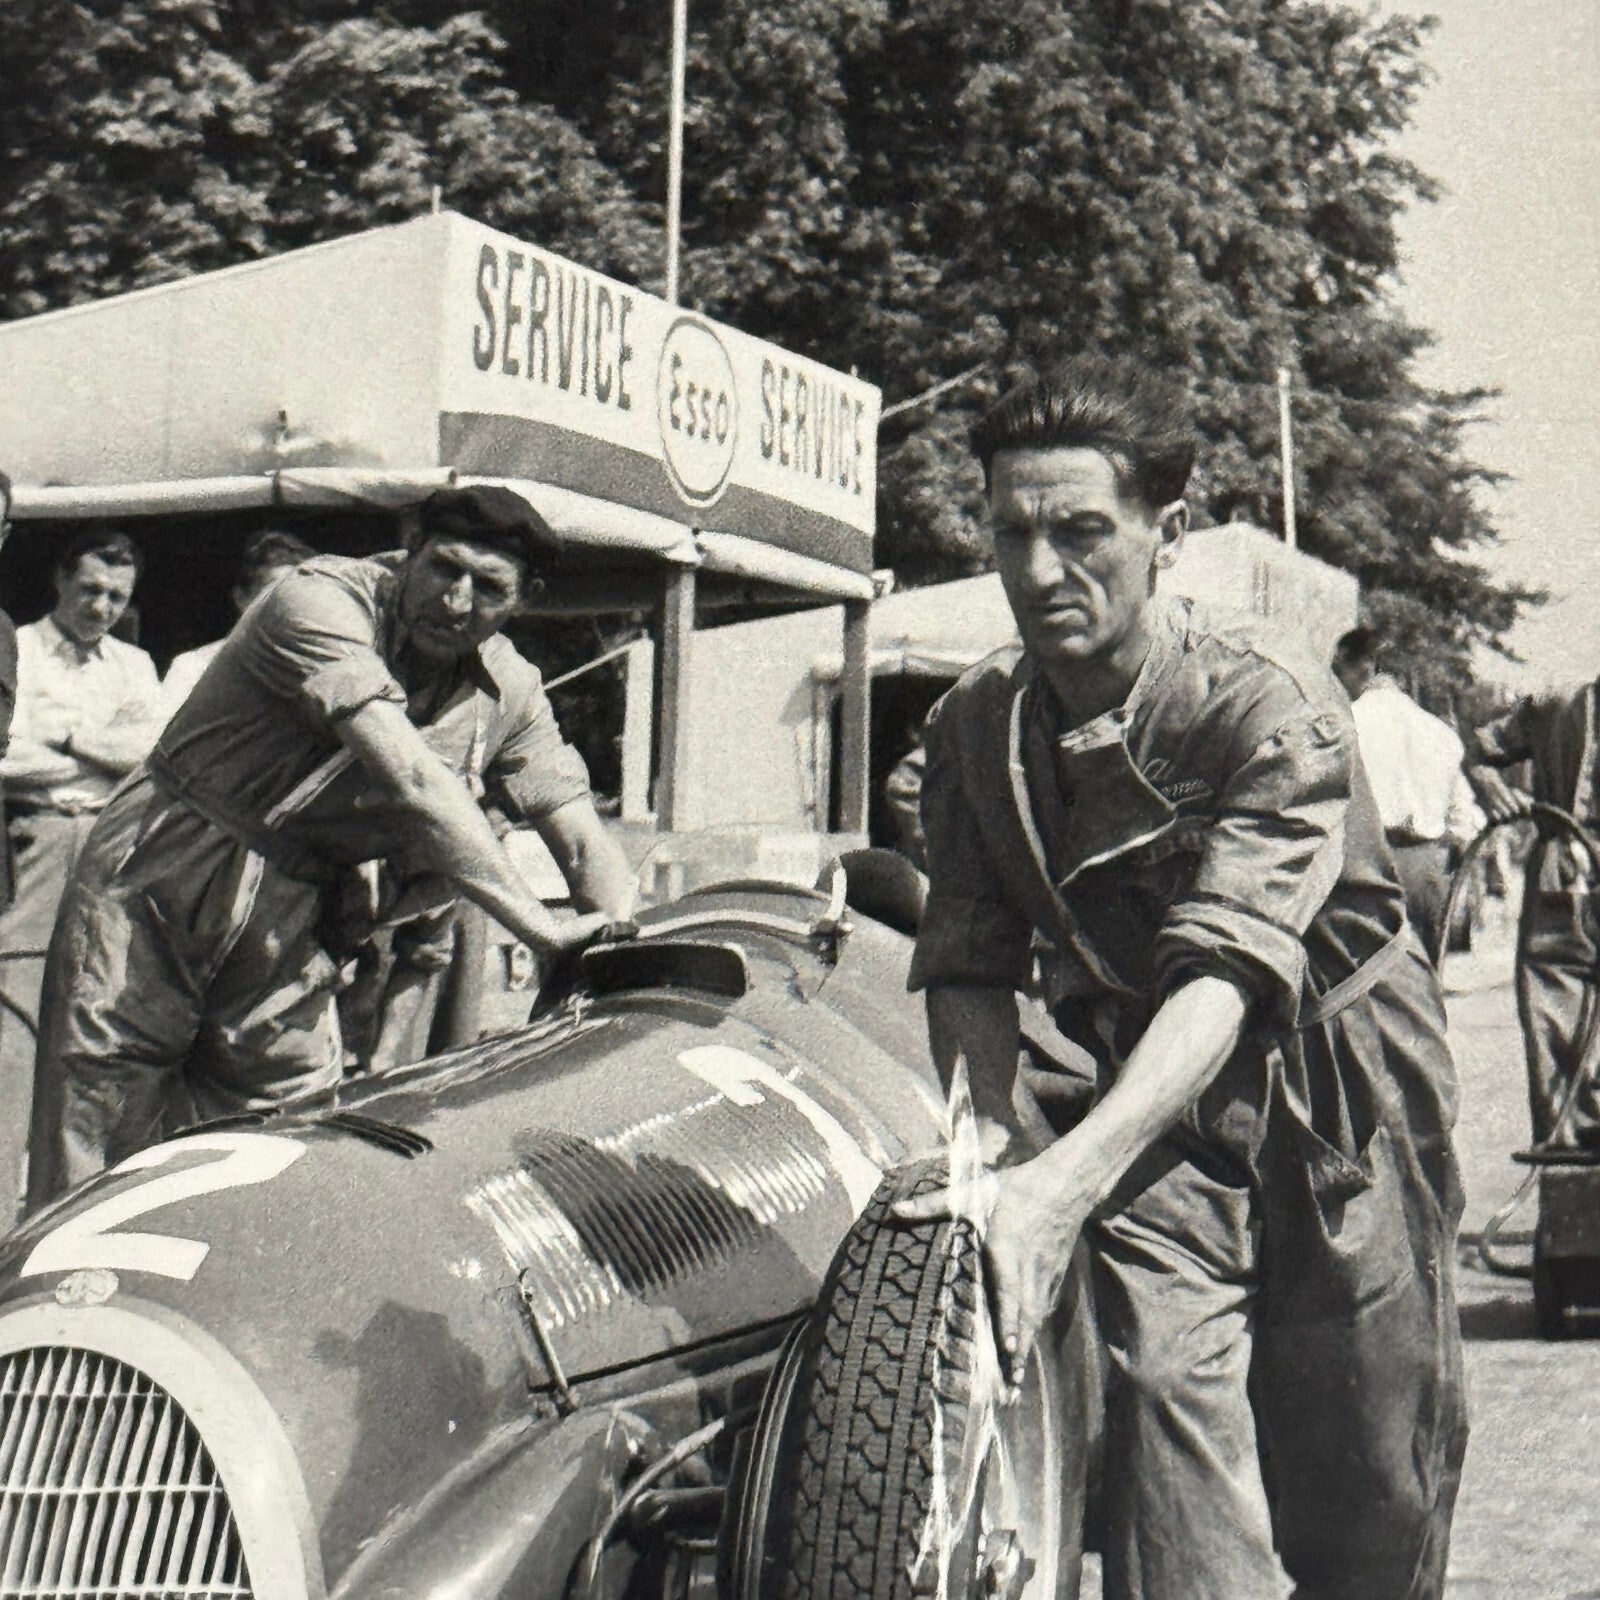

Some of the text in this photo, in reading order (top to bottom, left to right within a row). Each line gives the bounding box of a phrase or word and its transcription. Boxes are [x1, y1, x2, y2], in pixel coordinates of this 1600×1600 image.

[473, 243, 634, 411] SERVICE
[760, 358, 865, 496] SERVICE
[20, 1132, 307, 1281] 2
